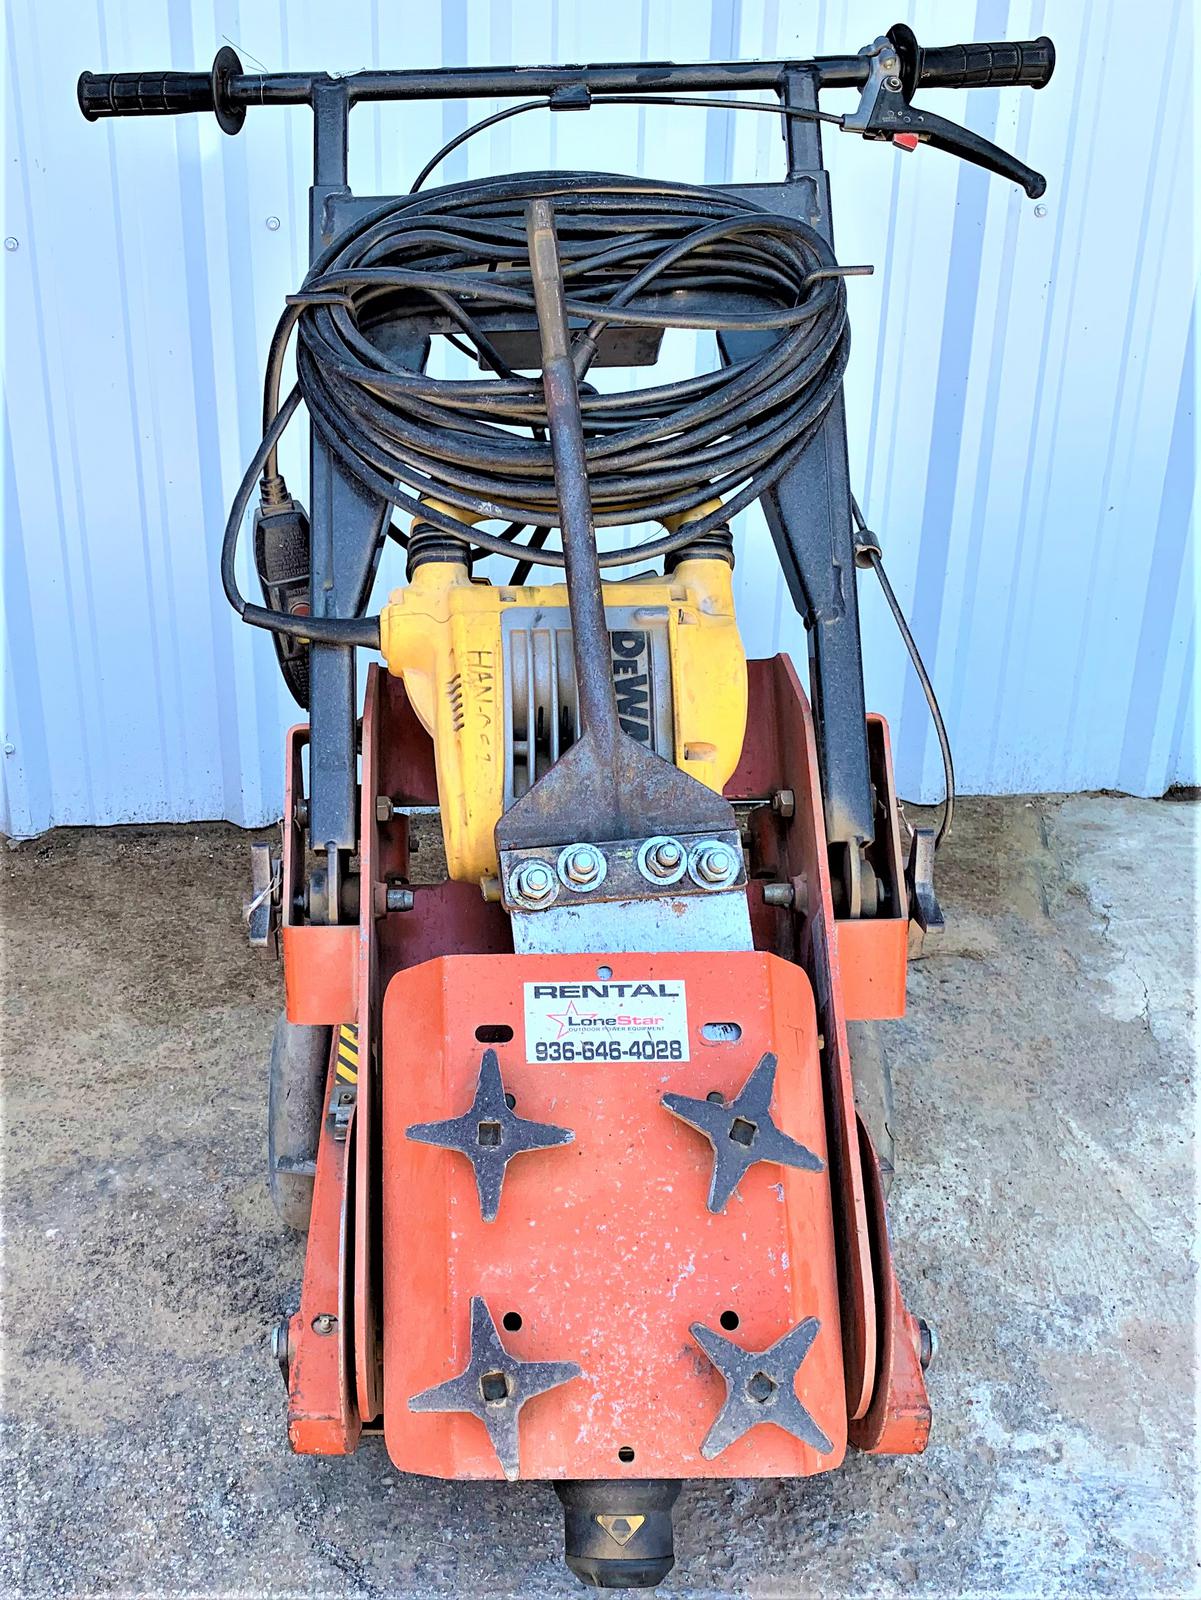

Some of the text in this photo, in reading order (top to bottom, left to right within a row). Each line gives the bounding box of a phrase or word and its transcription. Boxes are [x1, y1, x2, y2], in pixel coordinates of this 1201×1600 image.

[611, 631, 649, 741] DEWA
[534, 984, 679, 998] RENTAL
[568, 1015, 664, 1026] LoneStar
[535, 1040, 682, 1061] 936-646-4028
